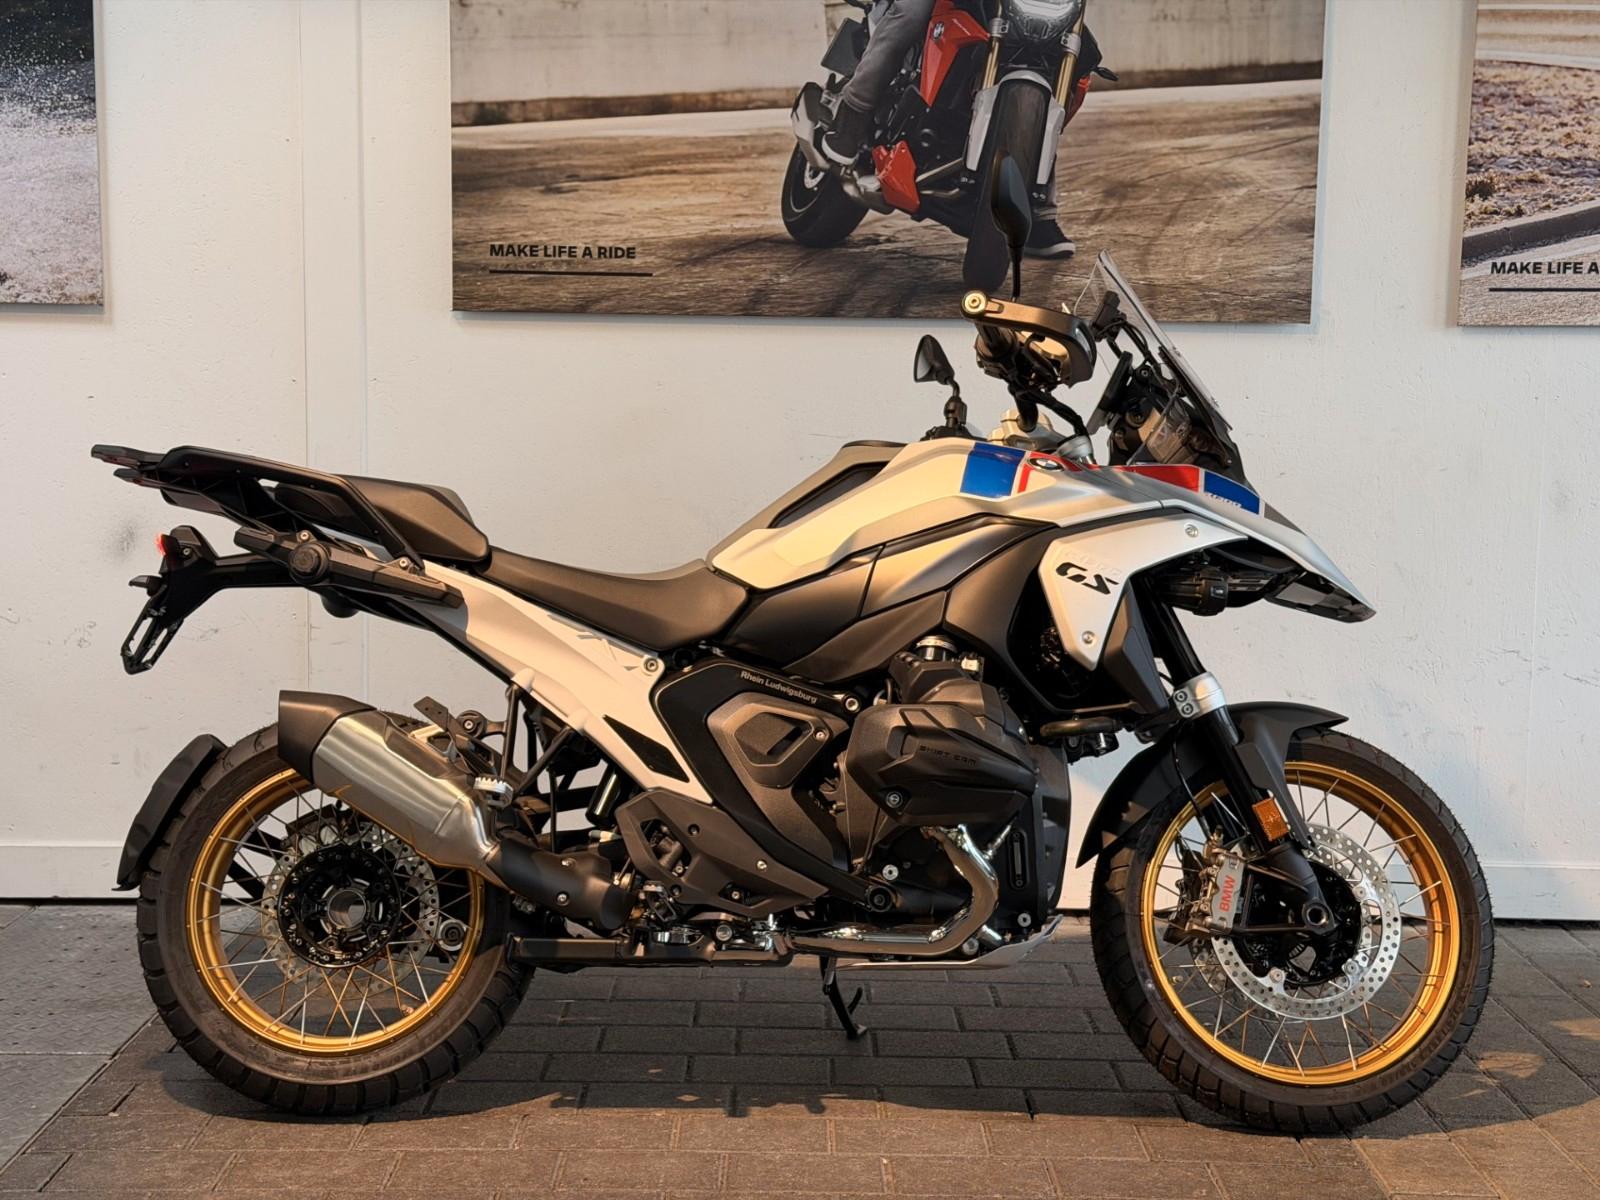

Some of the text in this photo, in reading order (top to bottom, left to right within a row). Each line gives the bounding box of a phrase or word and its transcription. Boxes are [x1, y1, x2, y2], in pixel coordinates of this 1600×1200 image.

[489, 243, 637, 261] MAKE LIFE A RIDE
[1490, 261, 1600, 275] MAKE LIFE A
[740, 670, 817, 704] Rhein Ludwigsburg
[1219, 875, 1235, 912] BMW
